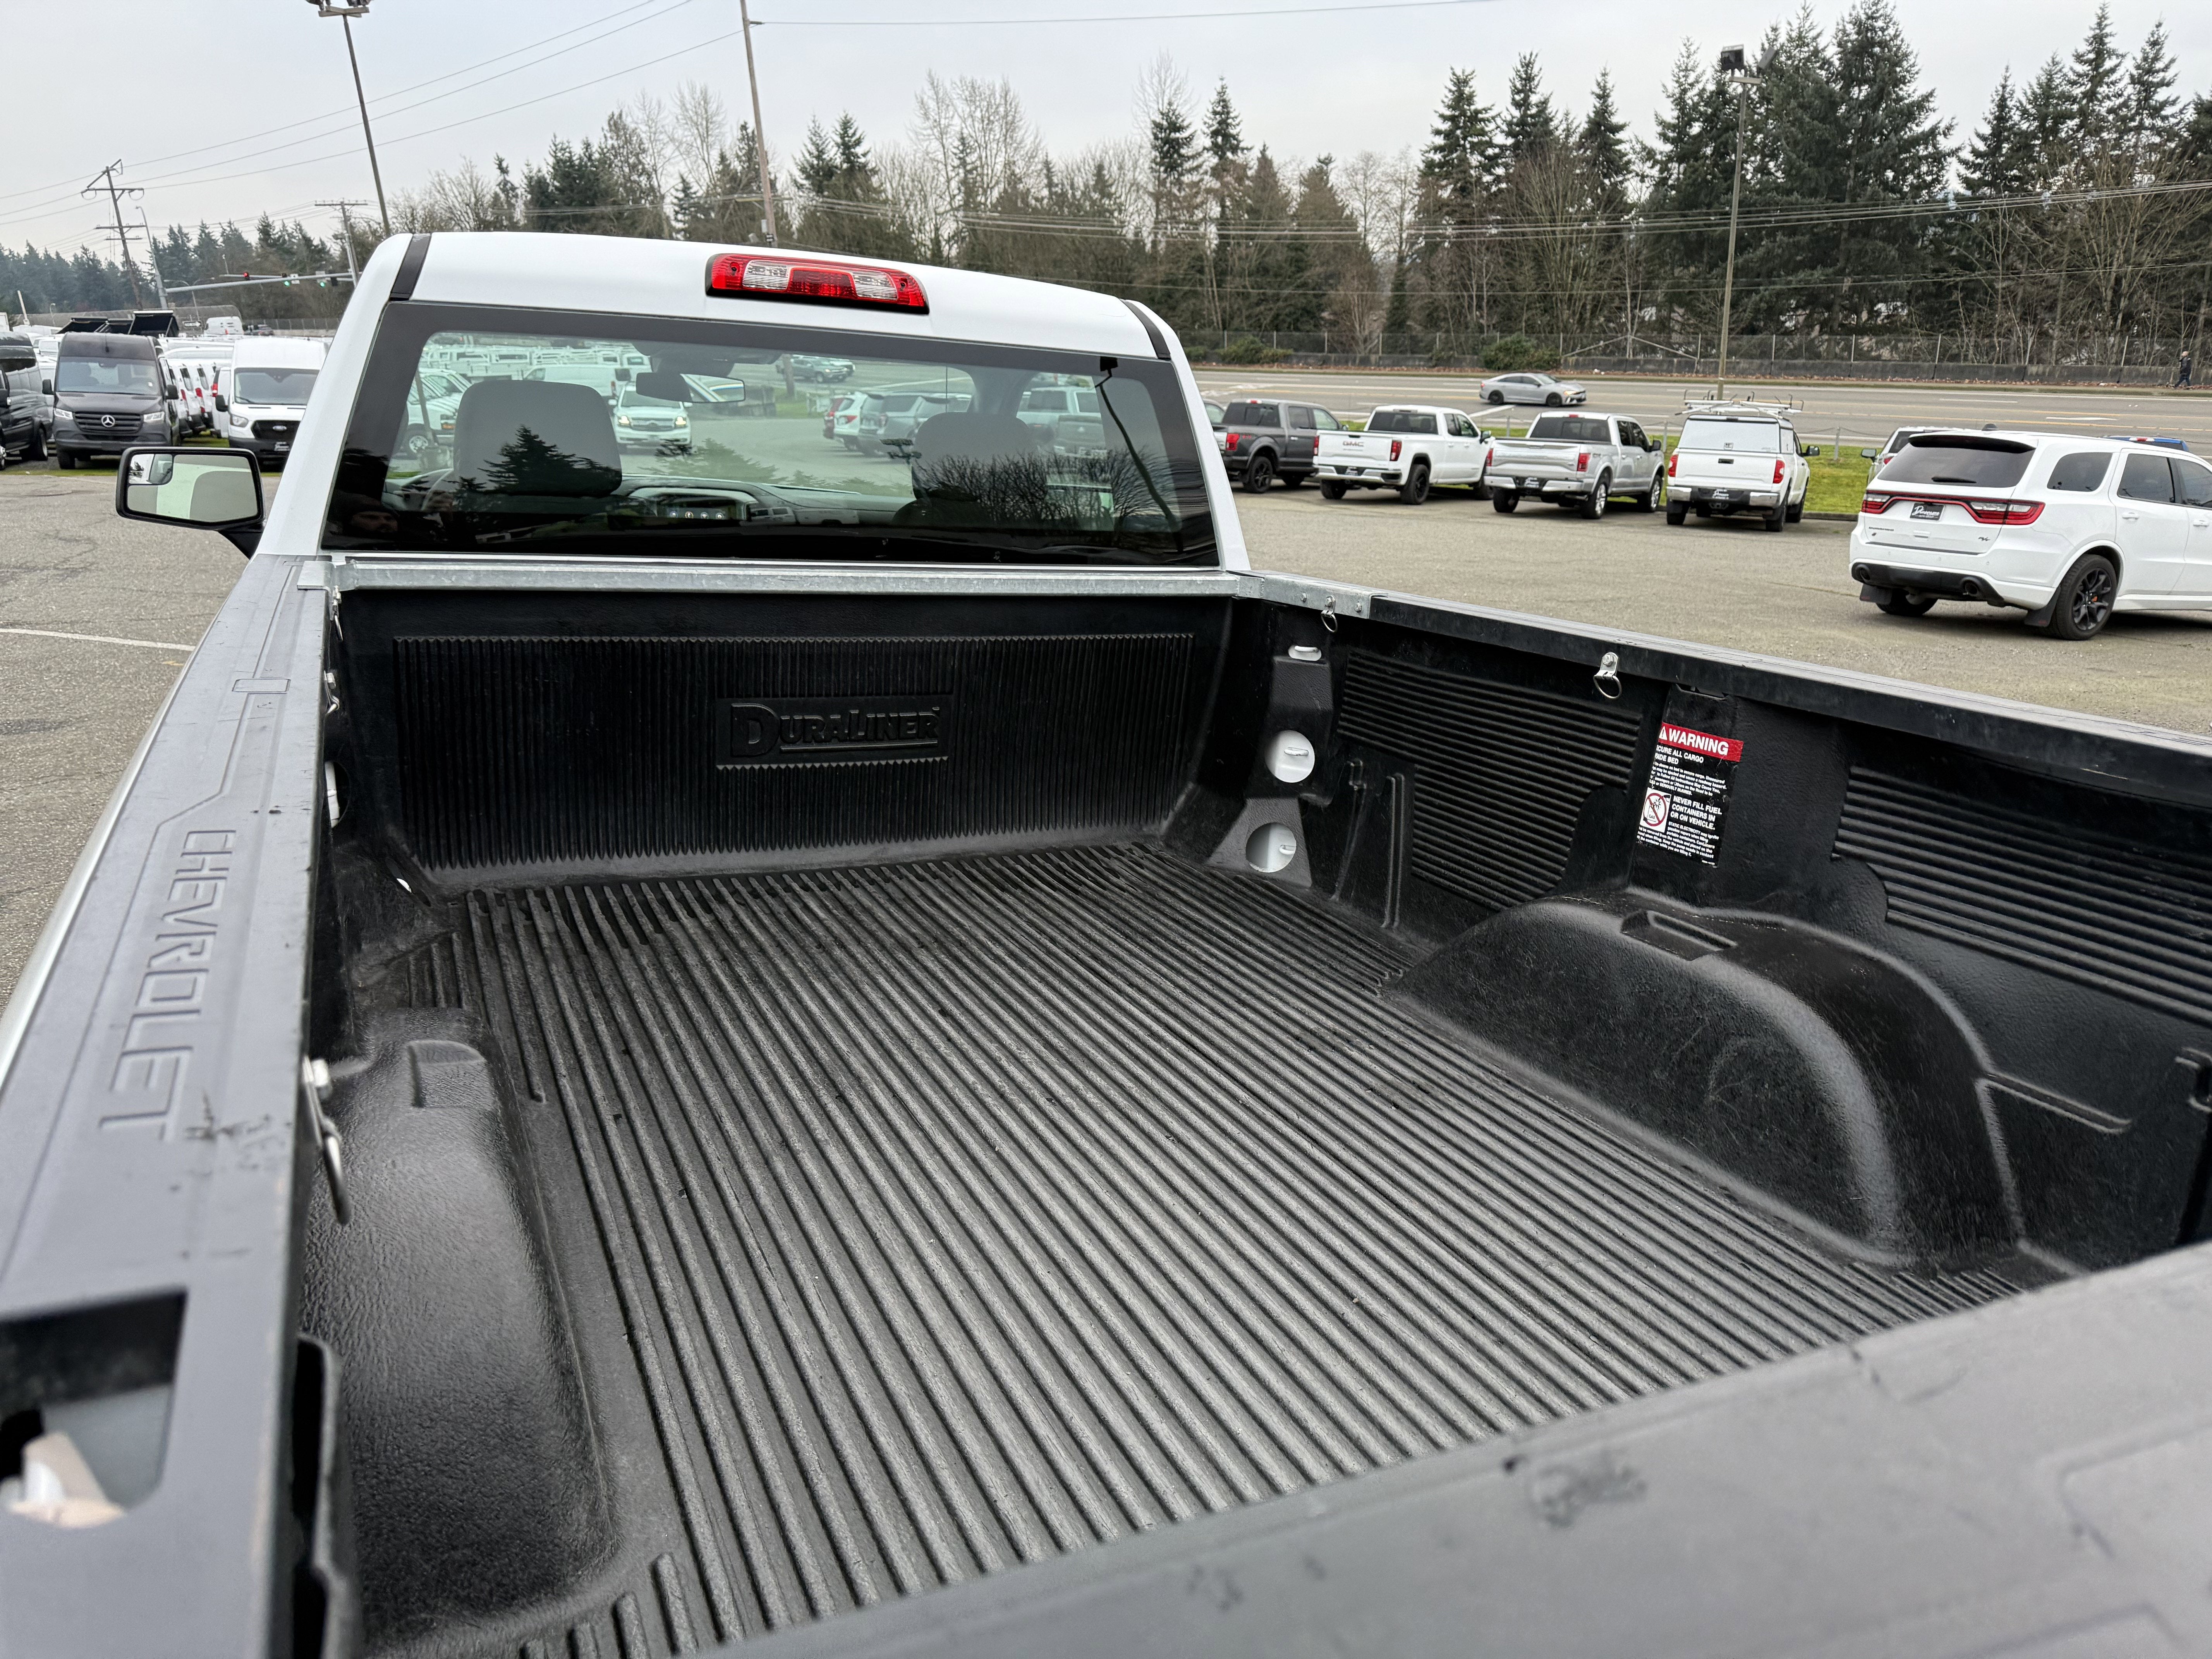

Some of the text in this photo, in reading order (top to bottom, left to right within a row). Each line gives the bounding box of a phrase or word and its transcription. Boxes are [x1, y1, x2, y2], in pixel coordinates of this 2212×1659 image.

[1669, 728, 1729, 755] WARNING
[1667, 756, 1679, 765] BED
[1672, 749, 1683, 758] ALL
[1683, 752, 1704, 763] CARGO
[1671, 803, 1716, 822] CONTAINERS IN
[1673, 795, 1723, 815] NEVER FILL FUEL
[1670, 811, 1716, 830] OR ON VEHICLE.
